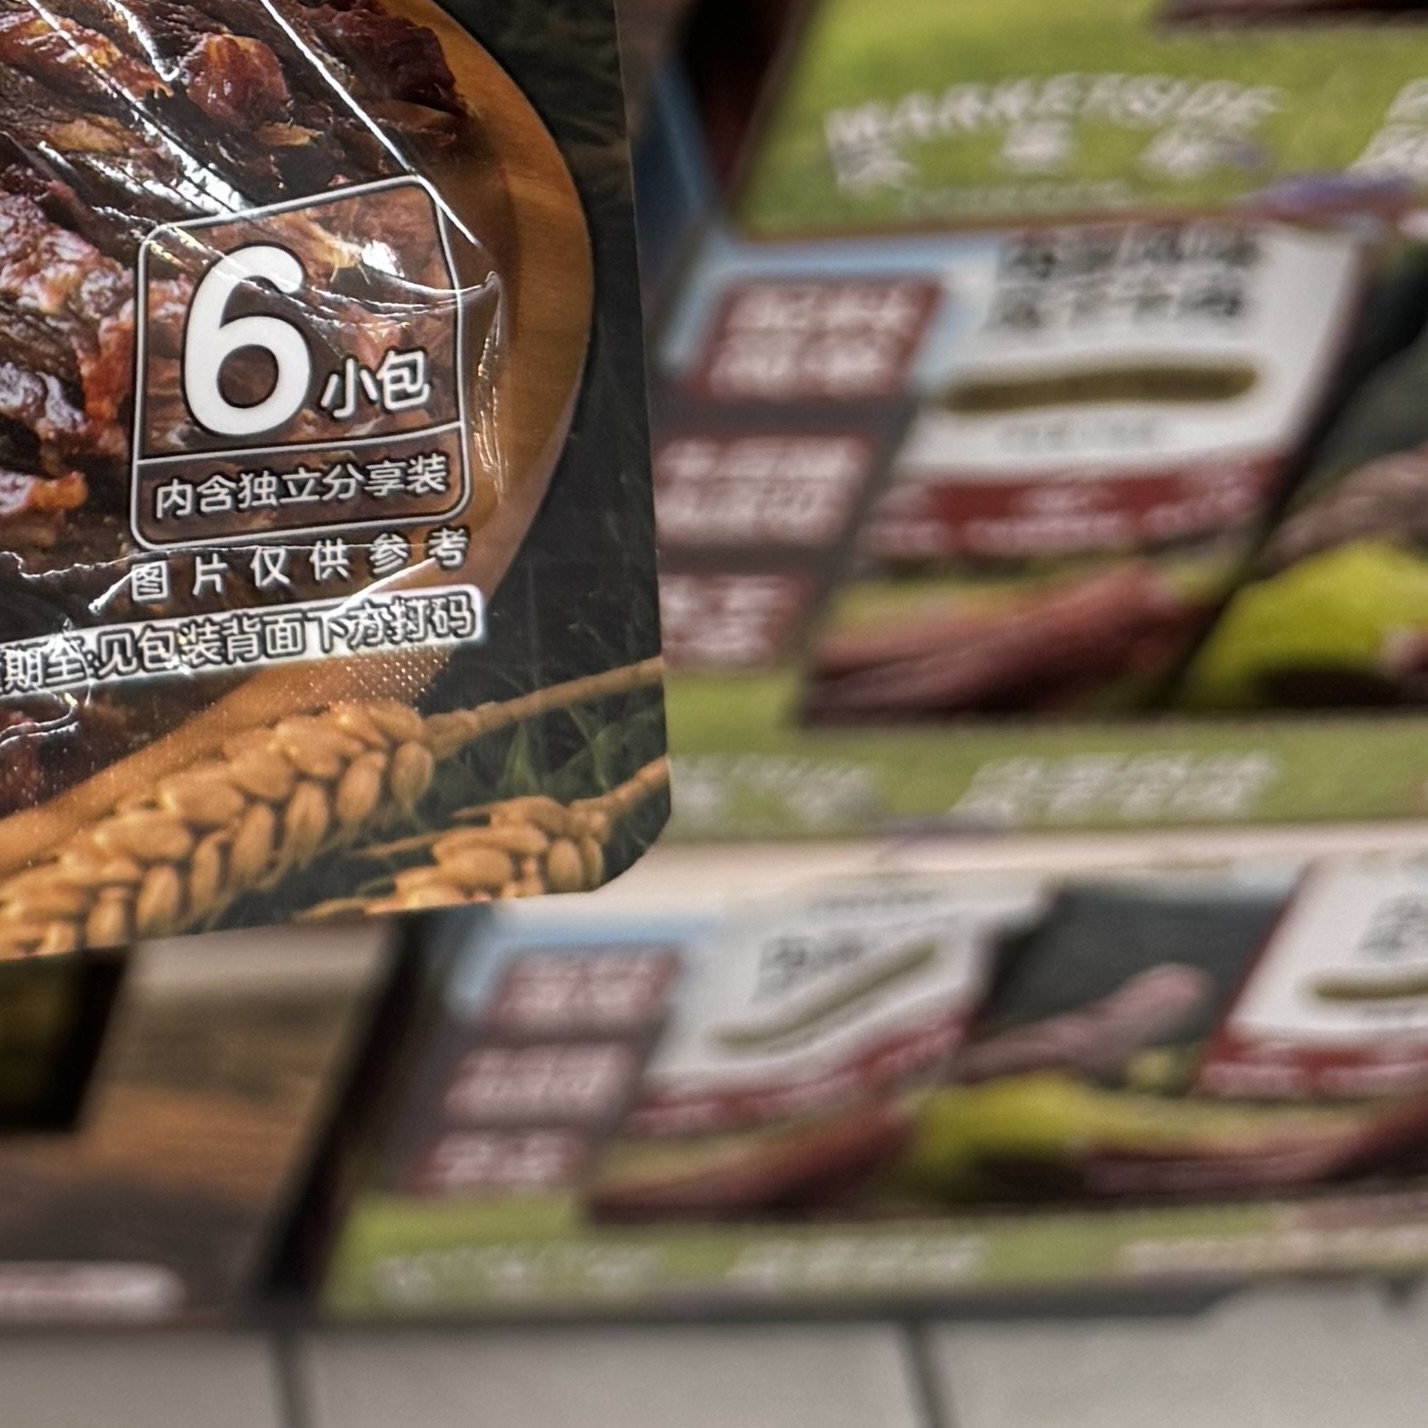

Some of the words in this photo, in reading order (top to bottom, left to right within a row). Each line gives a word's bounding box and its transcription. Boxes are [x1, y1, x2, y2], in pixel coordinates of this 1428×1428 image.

[155, 452, 449, 520] 内含独立分享装
[130, 526, 471, 603] 图片仅供参考
